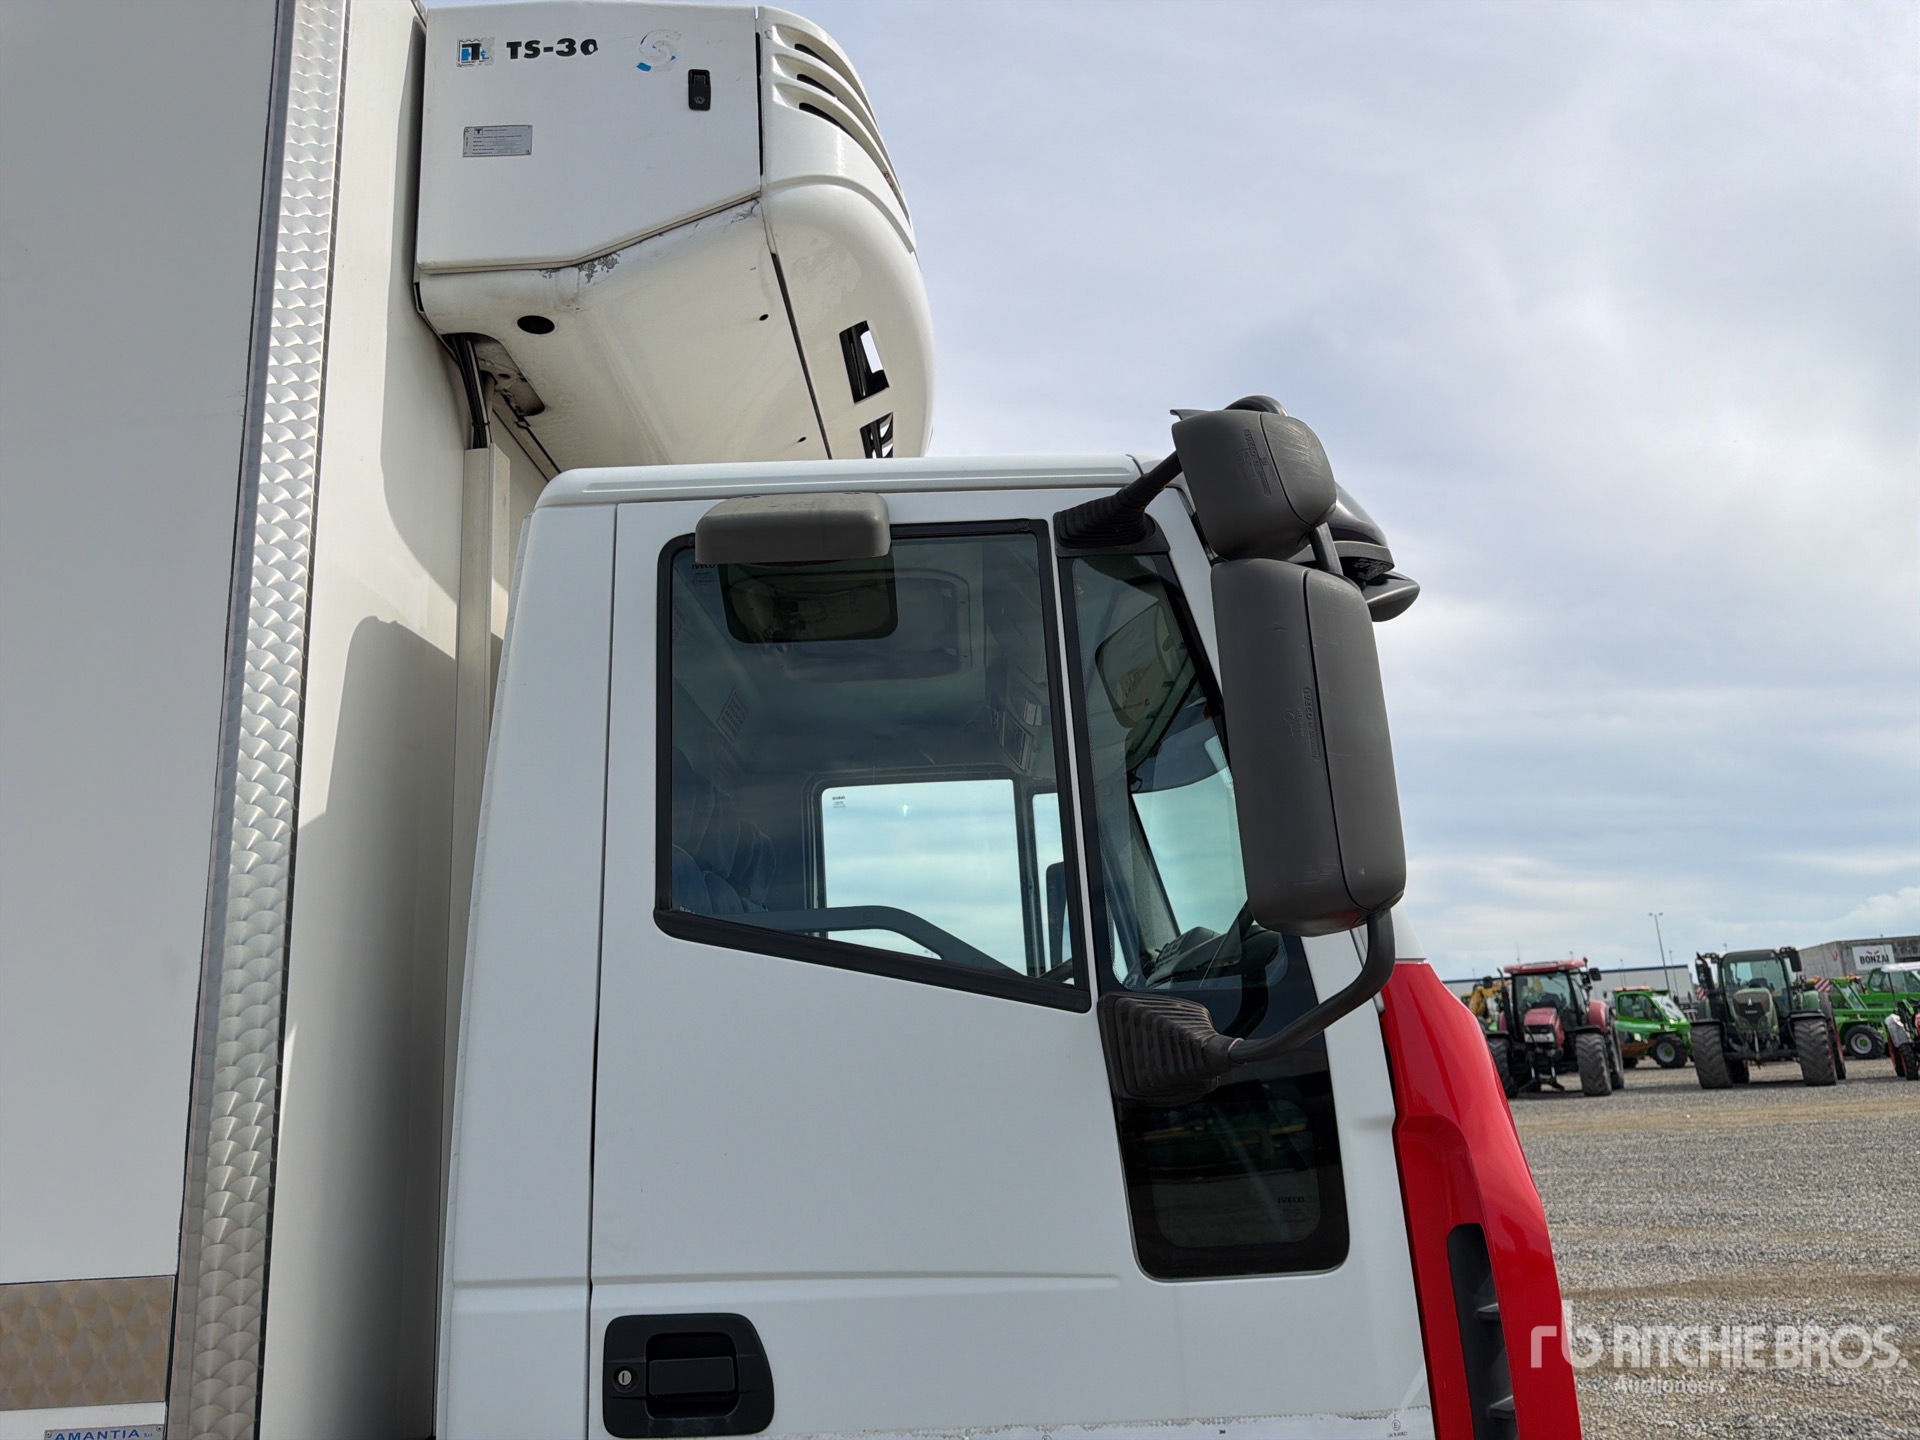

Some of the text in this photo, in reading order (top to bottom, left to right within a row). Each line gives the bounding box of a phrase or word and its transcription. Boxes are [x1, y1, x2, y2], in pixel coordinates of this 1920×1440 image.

[506, 38, 599, 60] TS-30
[1859, 953, 1890, 965] BONZAI
[54, 1429, 140, 1440] AMANTIA
